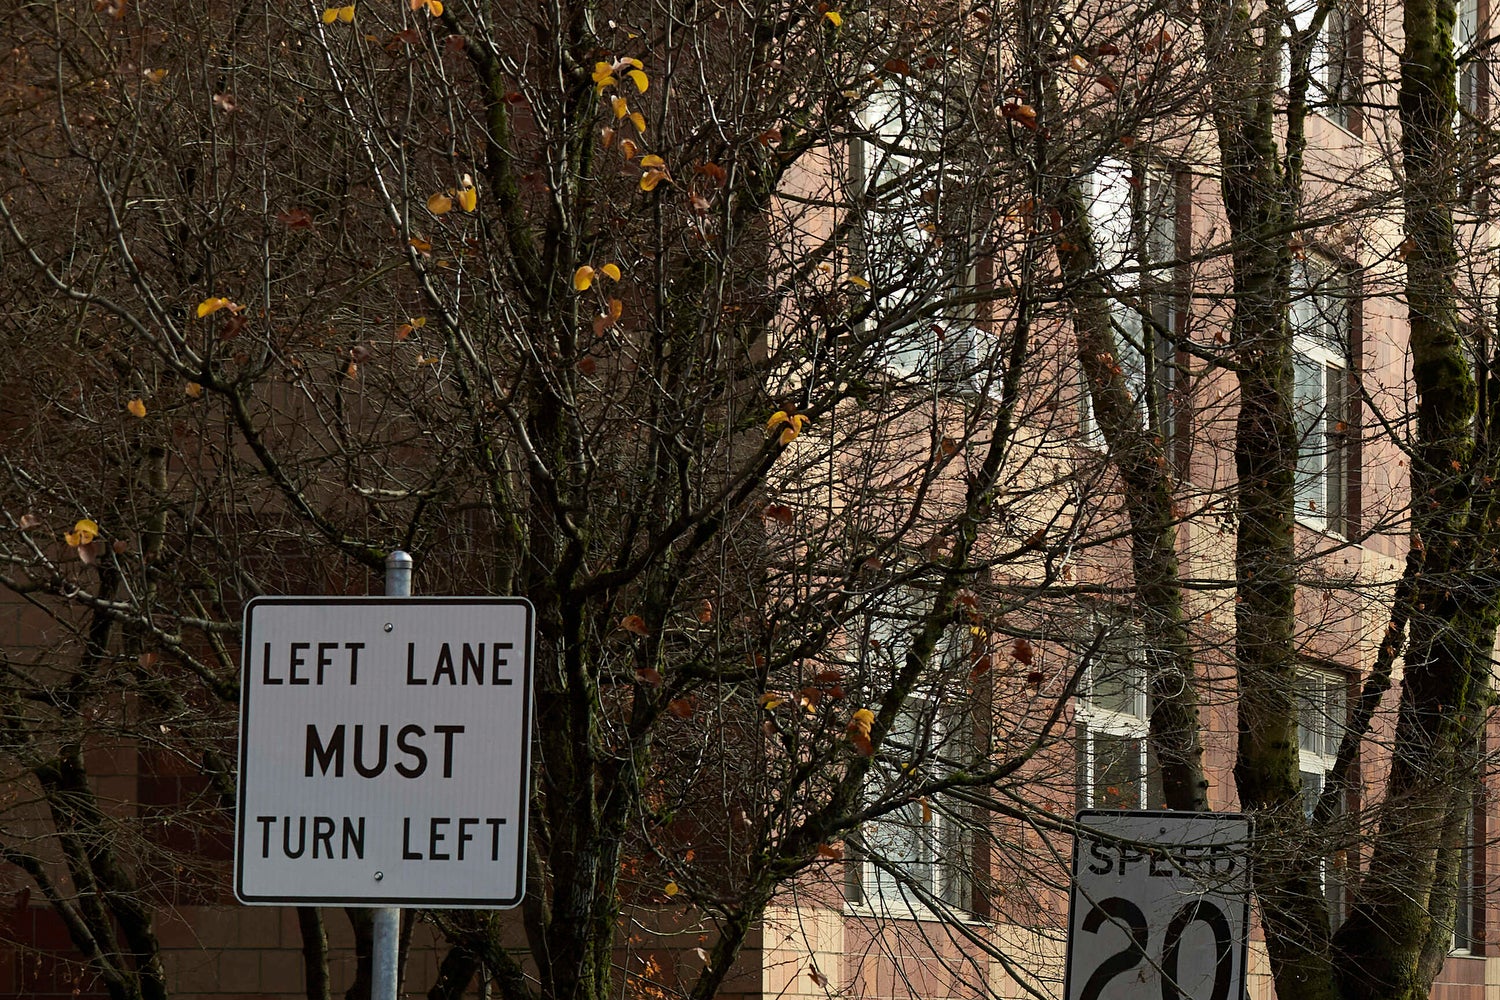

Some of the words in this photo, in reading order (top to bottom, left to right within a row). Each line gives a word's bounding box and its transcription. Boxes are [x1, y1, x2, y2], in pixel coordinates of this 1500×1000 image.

[263, 642, 365, 685] LEFT
[406, 642, 513, 686] LANE
[304, 723, 465, 779] MUST
[256, 816, 366, 859] TURN
[402, 817, 506, 861] LEFT
